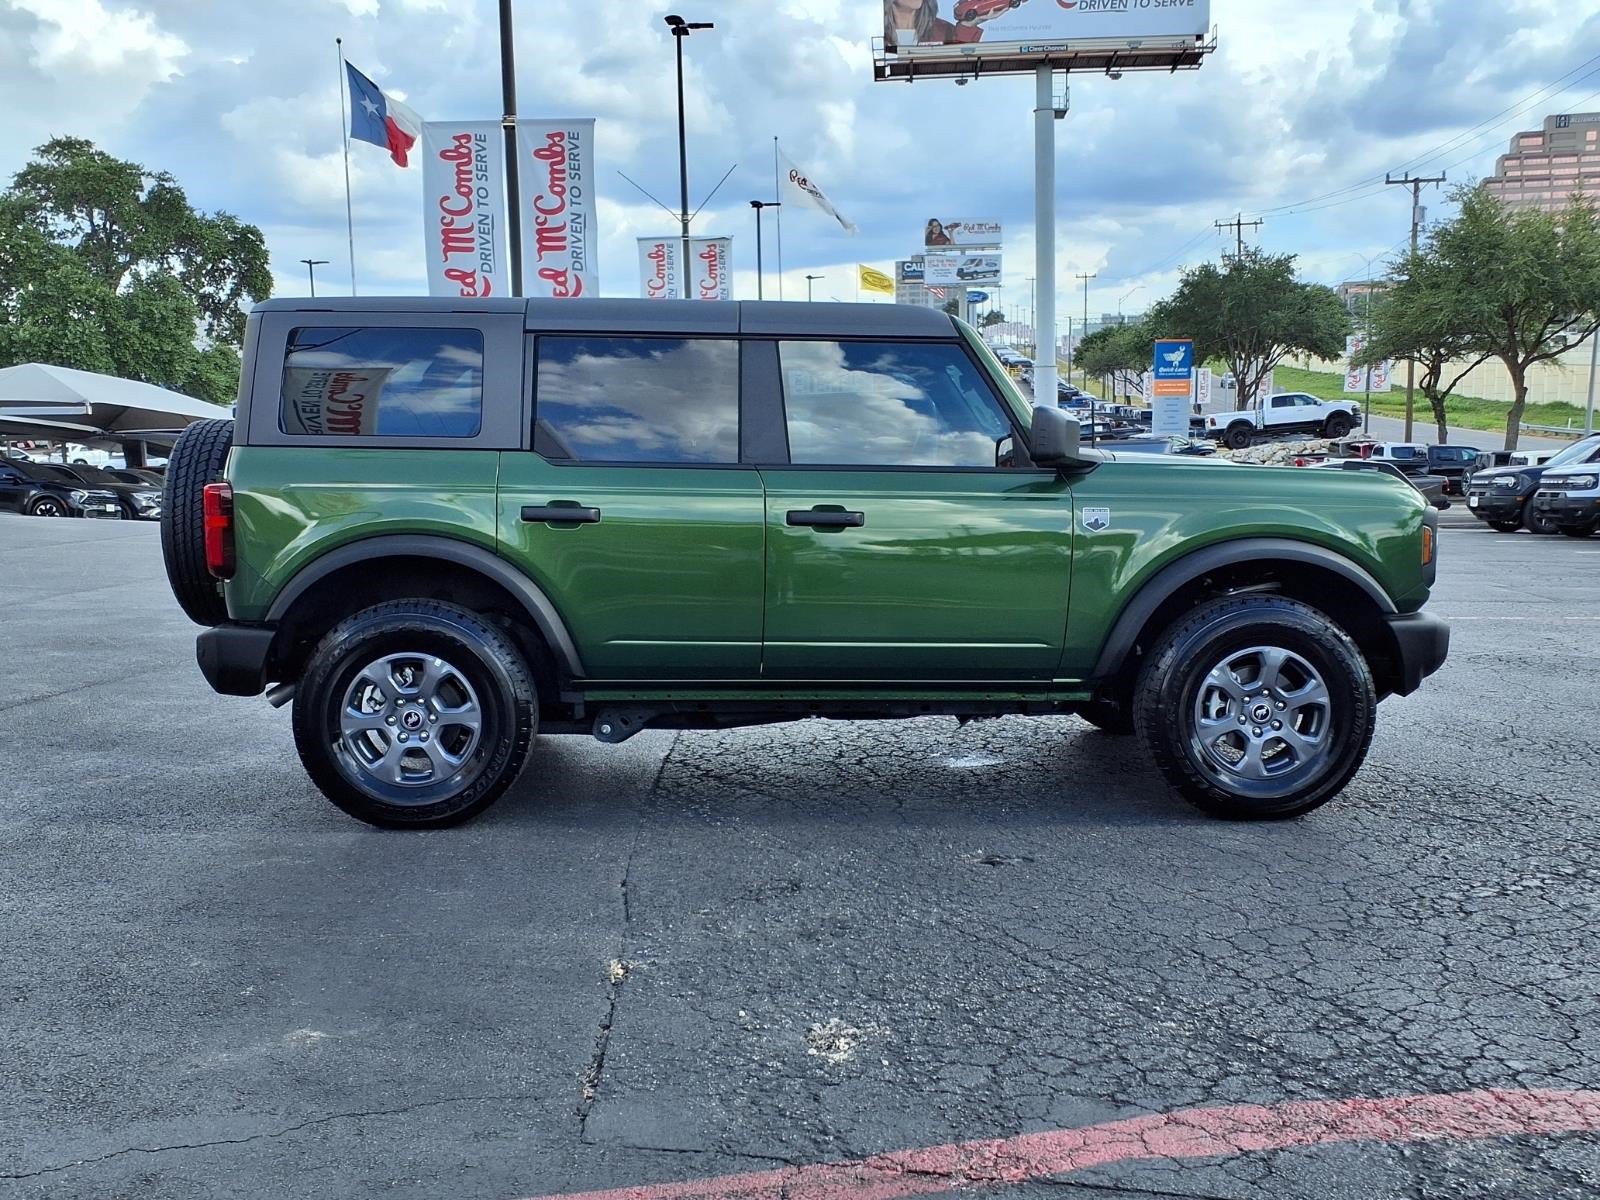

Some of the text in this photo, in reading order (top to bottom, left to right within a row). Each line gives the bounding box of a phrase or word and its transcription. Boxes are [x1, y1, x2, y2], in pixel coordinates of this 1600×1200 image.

[1079, 0, 1128, 10] DRIVEN
[1133, 0, 1151, 8] TO
[439, 133, 478, 297] ed McCombs
[474, 133, 493, 273] DRIVEN TO SERVE
[533, 131, 569, 297] ed McCombs
[567, 131, 584, 272] DRIVEN TO SERVE
[666, 243, 674, 270] SERVE
